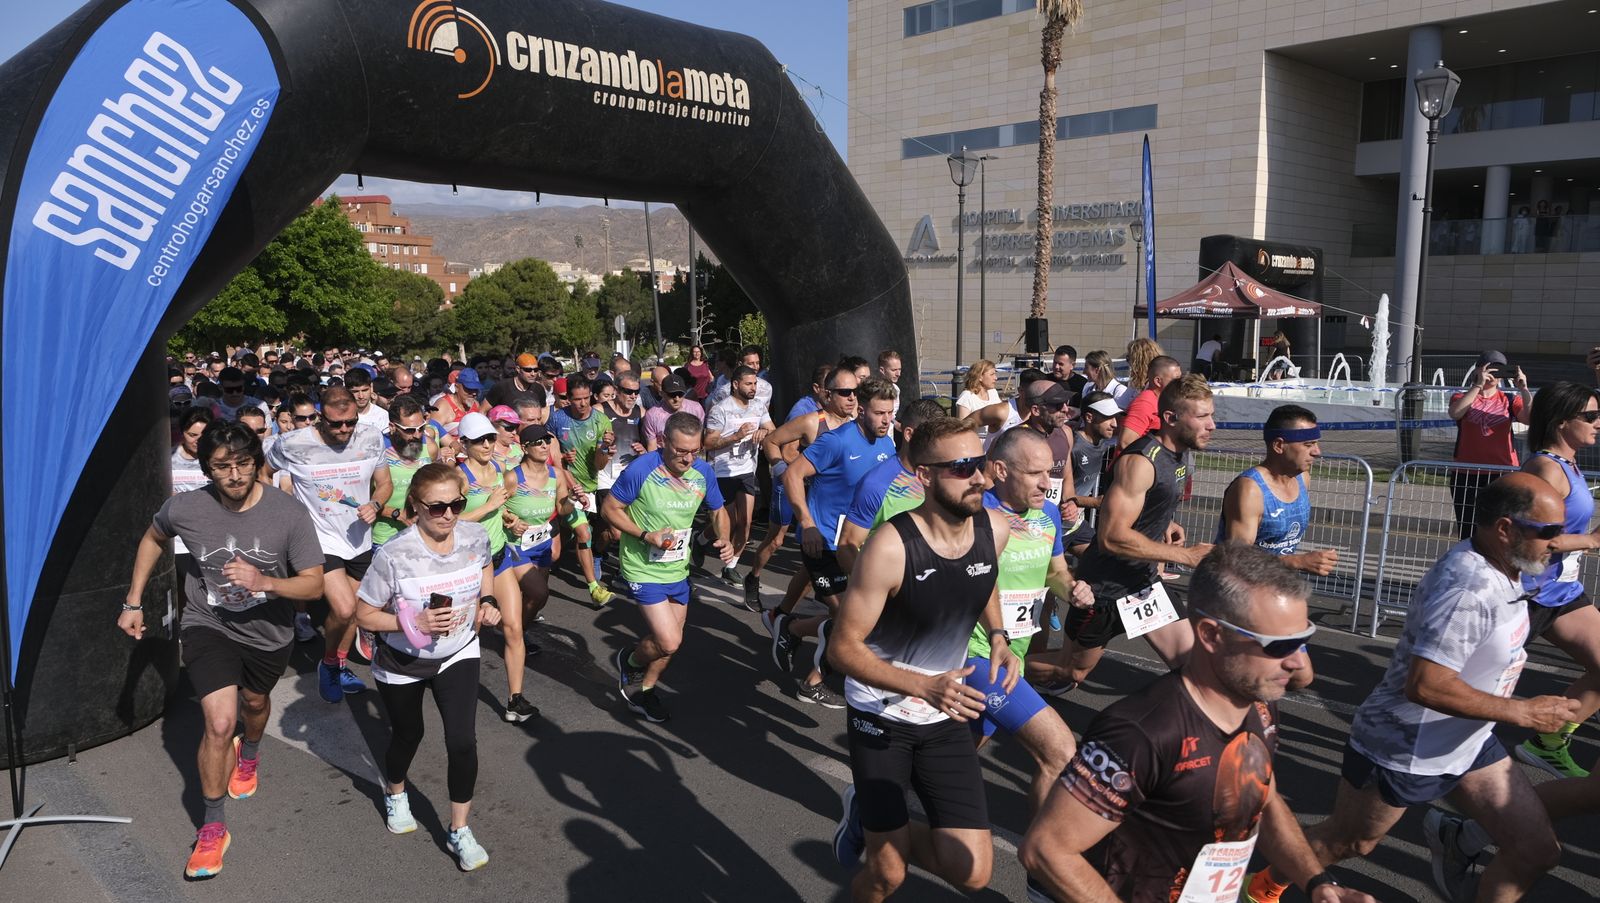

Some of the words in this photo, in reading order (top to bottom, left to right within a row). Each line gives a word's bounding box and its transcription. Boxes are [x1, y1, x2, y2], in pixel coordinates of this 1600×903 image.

[506, 31, 750, 110] cruzandolameta
[593, 90, 689, 118] cronometraje
[691, 105, 750, 127] deportivo
[147, 98, 270, 287] centrohogarsanchez.es
[667, 500, 697, 509] SAKAT
[1133, 599, 1161, 620] 181
